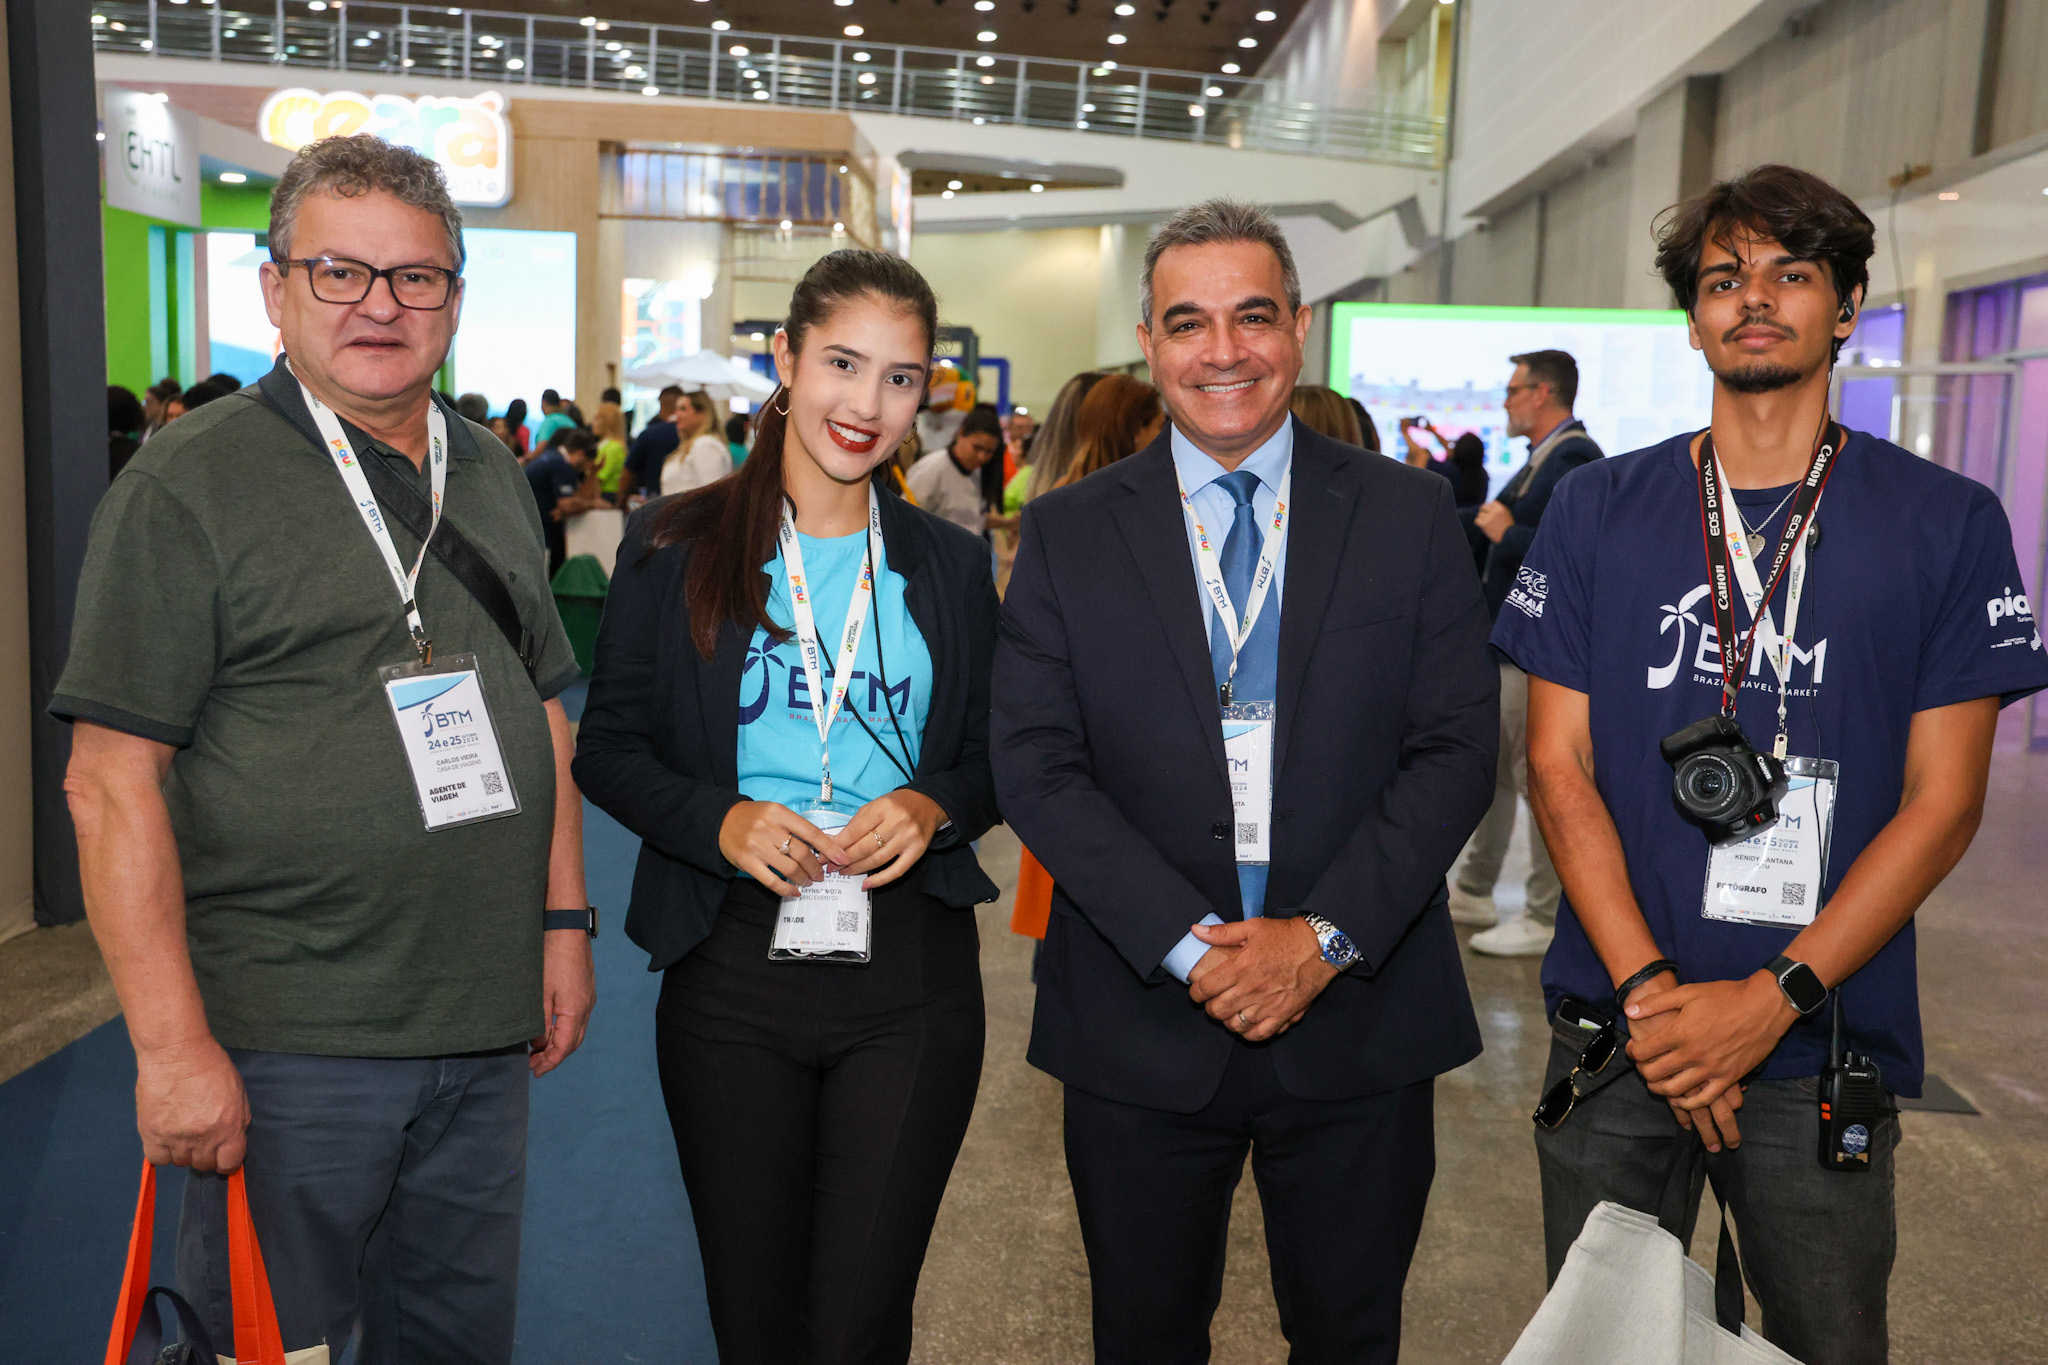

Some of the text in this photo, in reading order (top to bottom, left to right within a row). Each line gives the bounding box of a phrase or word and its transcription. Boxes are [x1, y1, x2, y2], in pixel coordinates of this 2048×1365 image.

[1806, 444, 1833, 488] Canon
[1704, 459, 1721, 537] EOS DIGITAL
[368, 509, 383, 533] BTM
[1785, 514, 1802, 540] EOS
[1257, 566, 1270, 589] BTM
[1715, 564, 1729, 611] Canon
[1212, 585, 1228, 609] BTM
[807, 646, 818, 670] BTM
[1693, 673, 1724, 686] BRAZI
[1740, 680, 1773, 693] RAVEL
[435, 708, 473, 728] BTM
[427, 739, 441, 750] 24
[442, 739, 449, 747] e
[449, 735, 462, 746] 25
[462, 736, 479, 744] 2024
[436, 752, 479, 766] CARLOS VIEIRA
[436, 765, 451, 773] CASA
[459, 759, 482, 768] VIAGENS
[1756, 756, 1774, 781] Canon
[429, 781, 467, 796] AGENTE DE
[430, 791, 459, 804] VIAGEM
[1734, 854, 1794, 866] KENIDY ANTANA
